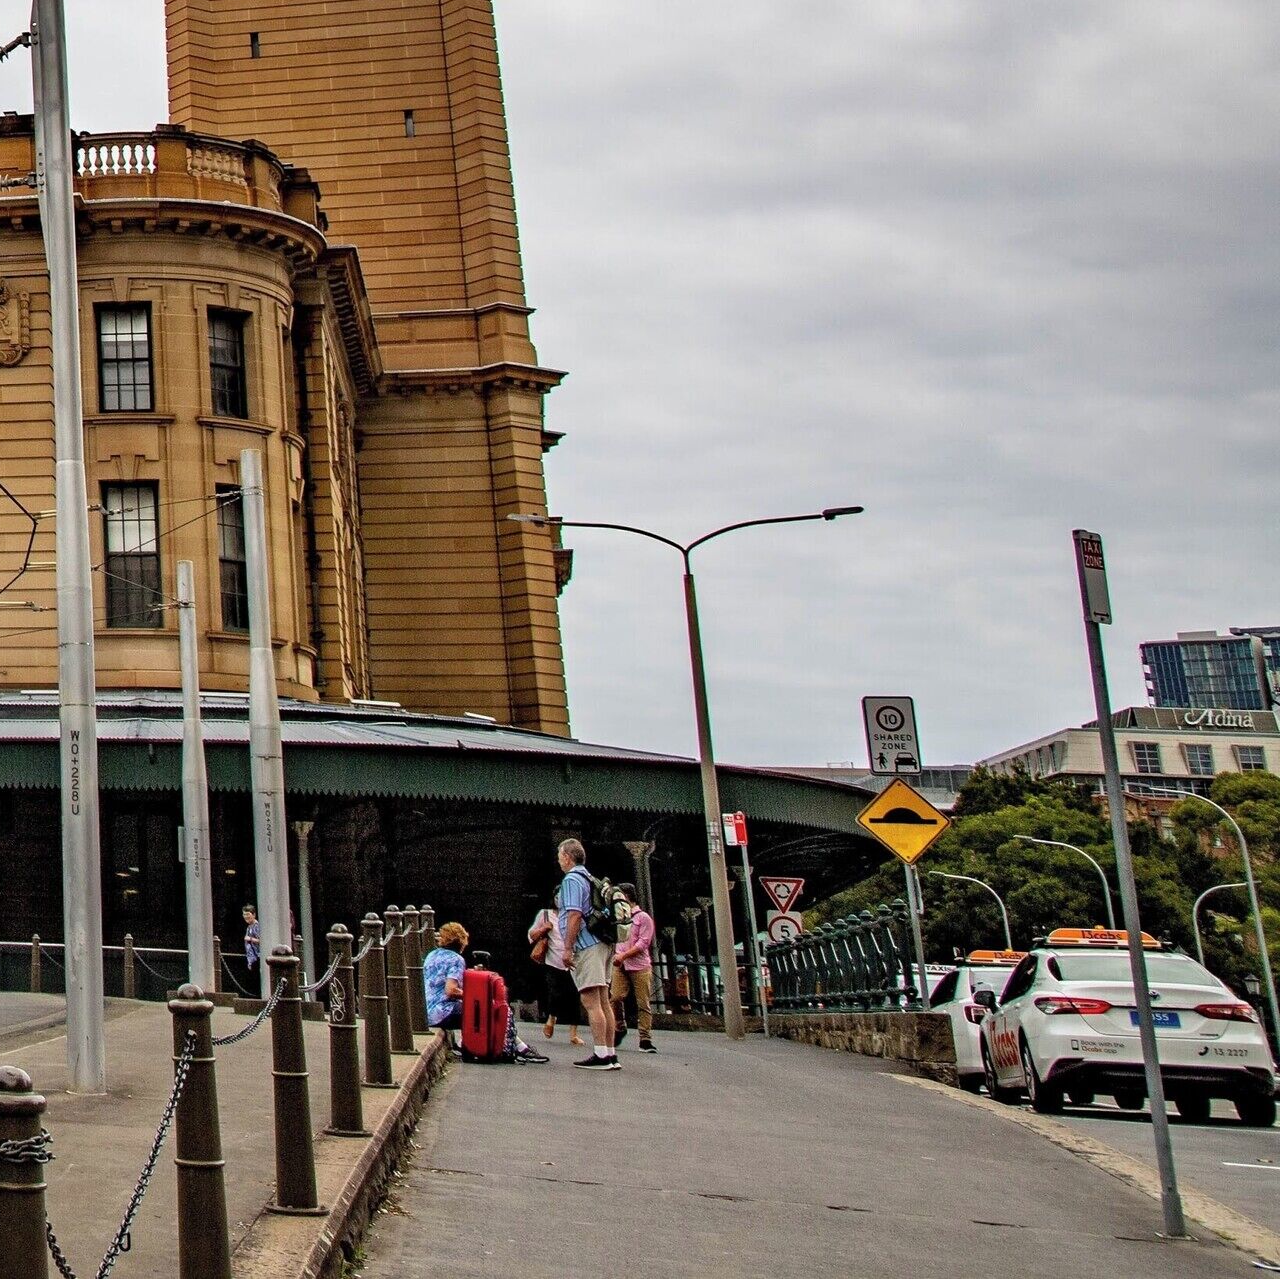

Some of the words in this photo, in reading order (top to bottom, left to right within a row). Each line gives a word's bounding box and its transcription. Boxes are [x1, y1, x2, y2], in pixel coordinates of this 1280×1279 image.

[1083, 540, 1102, 554] TAXI
[1085, 555, 1103, 568] ZONE
[884, 713, 897, 725] 10
[1184, 708, 1254, 728] Adina
[780, 925, 790, 938] 5
[1081, 930, 1123, 940] 13cabs
